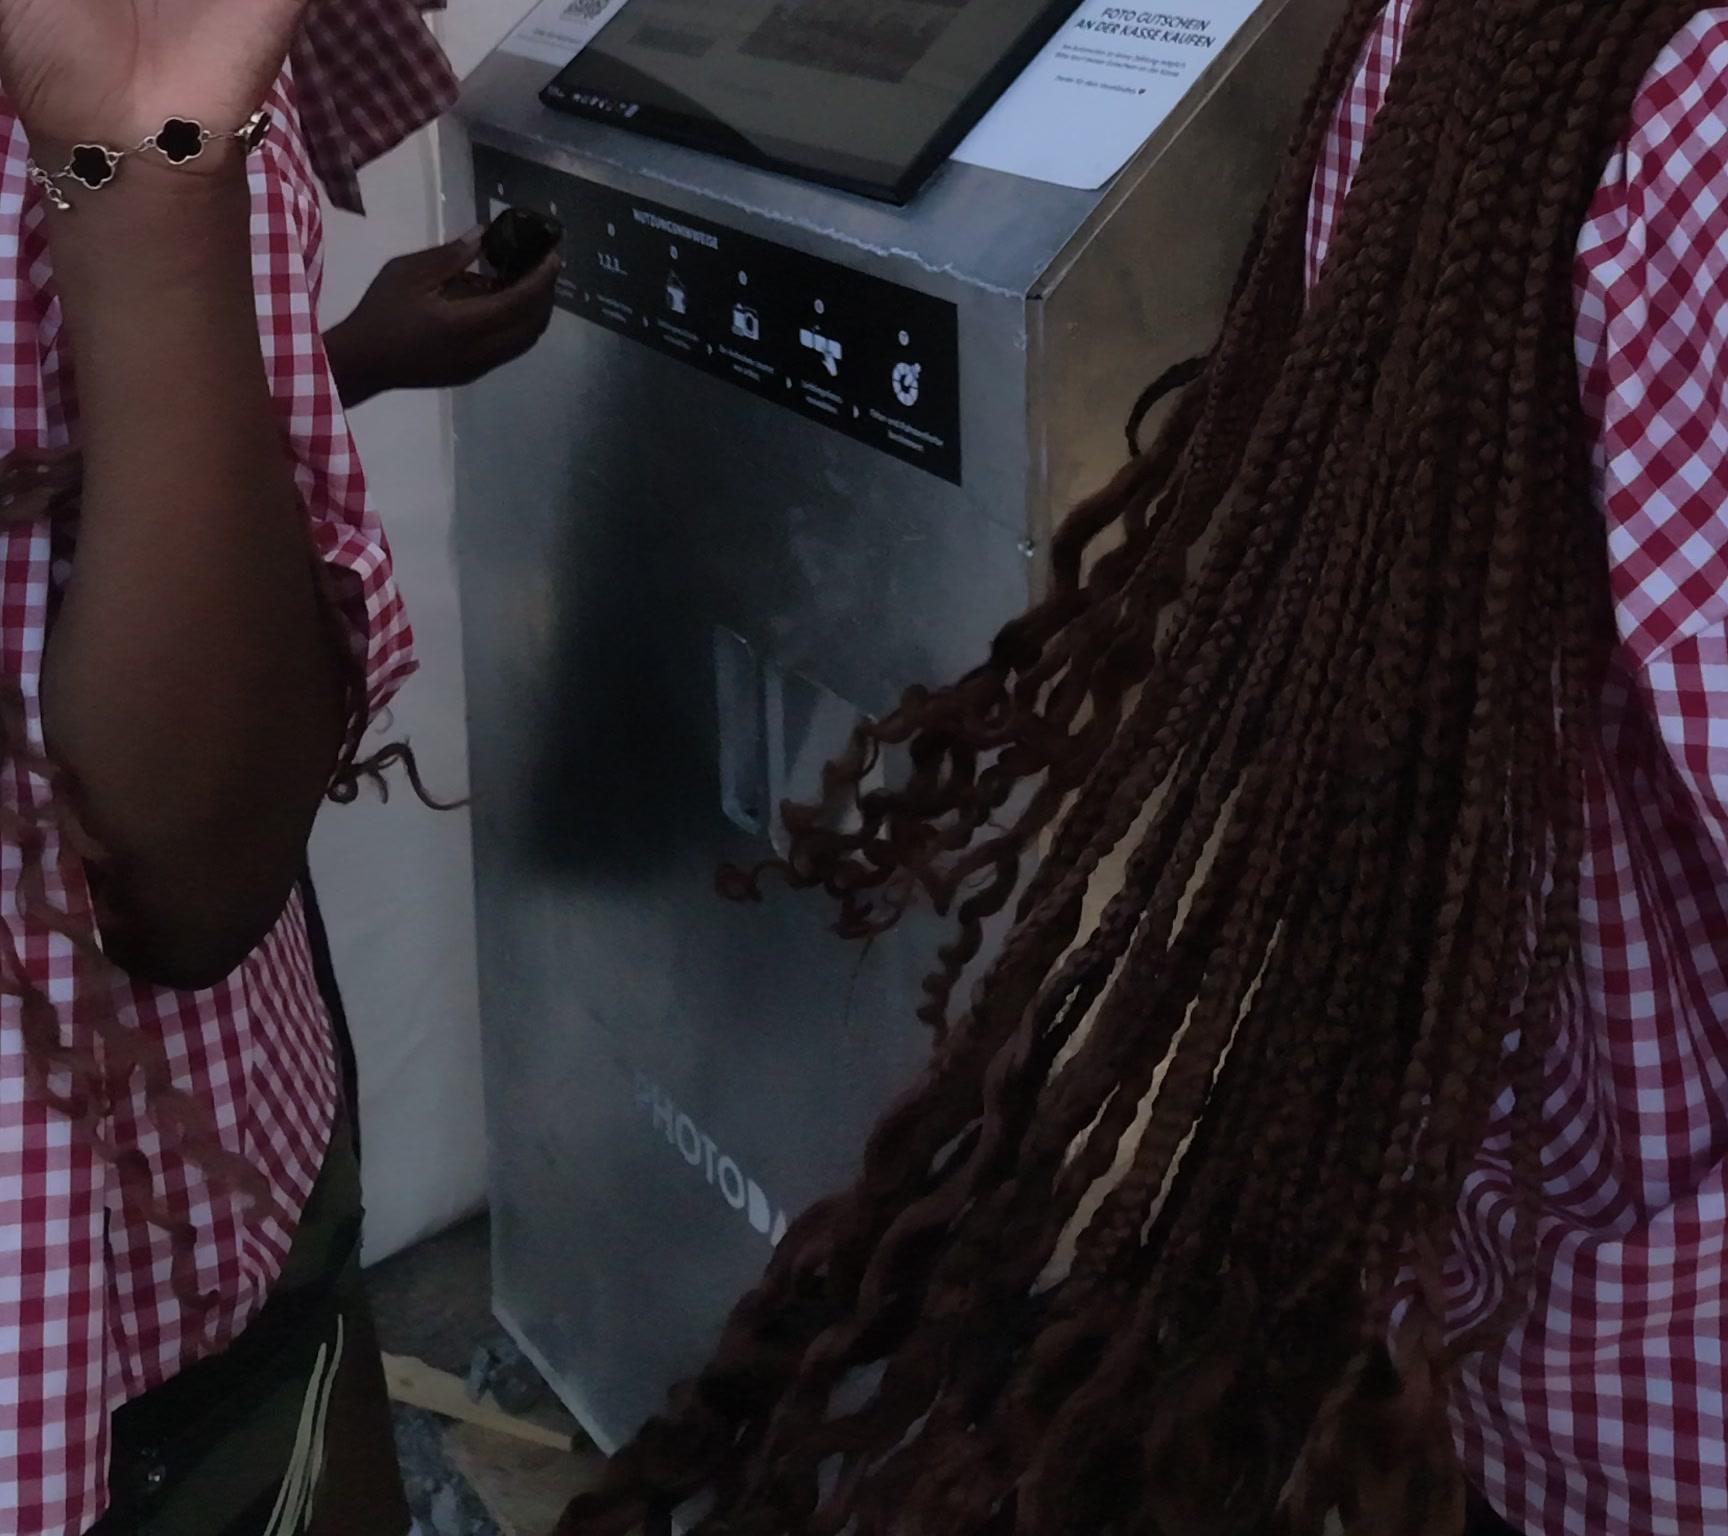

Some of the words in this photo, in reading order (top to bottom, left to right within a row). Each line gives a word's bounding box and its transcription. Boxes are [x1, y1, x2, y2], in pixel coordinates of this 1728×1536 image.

[1101, 7, 1137, 21] FOTO
[1136, 13, 1211, 32] GUTSCHEIN
[1075, 19, 1093, 30] AN
[1094, 22, 1121, 35] DER
[1119, 25, 1162, 41] KASSE
[1161, 31, 1217, 49] KAUFEN
